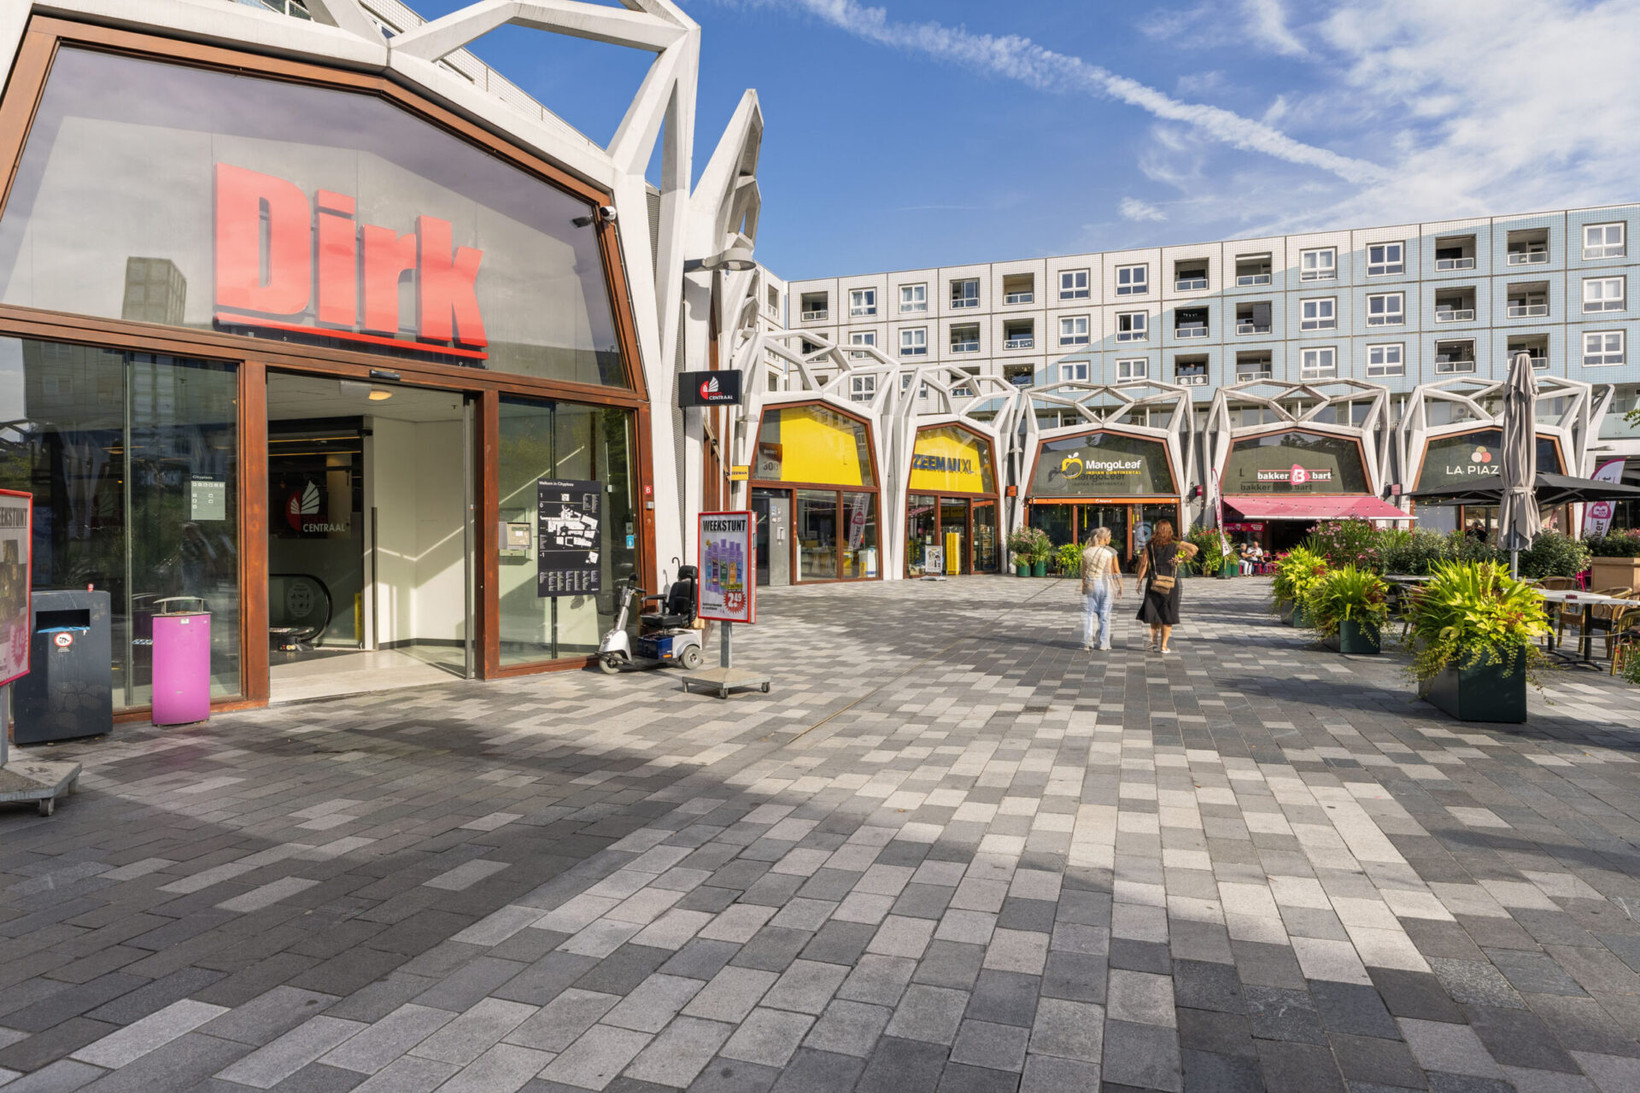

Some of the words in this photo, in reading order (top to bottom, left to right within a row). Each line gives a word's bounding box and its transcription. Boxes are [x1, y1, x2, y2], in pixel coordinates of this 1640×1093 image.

[213, 162, 488, 347] Dirk
[962, 459, 974, 474] XL
[1086, 460, 1141, 471] MangoLeaf
[1446, 466, 1463, 474] LA
[1467, 466, 1499, 474] PIAZ
[1257, 472, 1289, 480] bakker
[1312, 472, 1331, 480] bart
[302, 523, 346, 533] CENTRAAL
[703, 520, 746, 532] WEEKSTUNT
